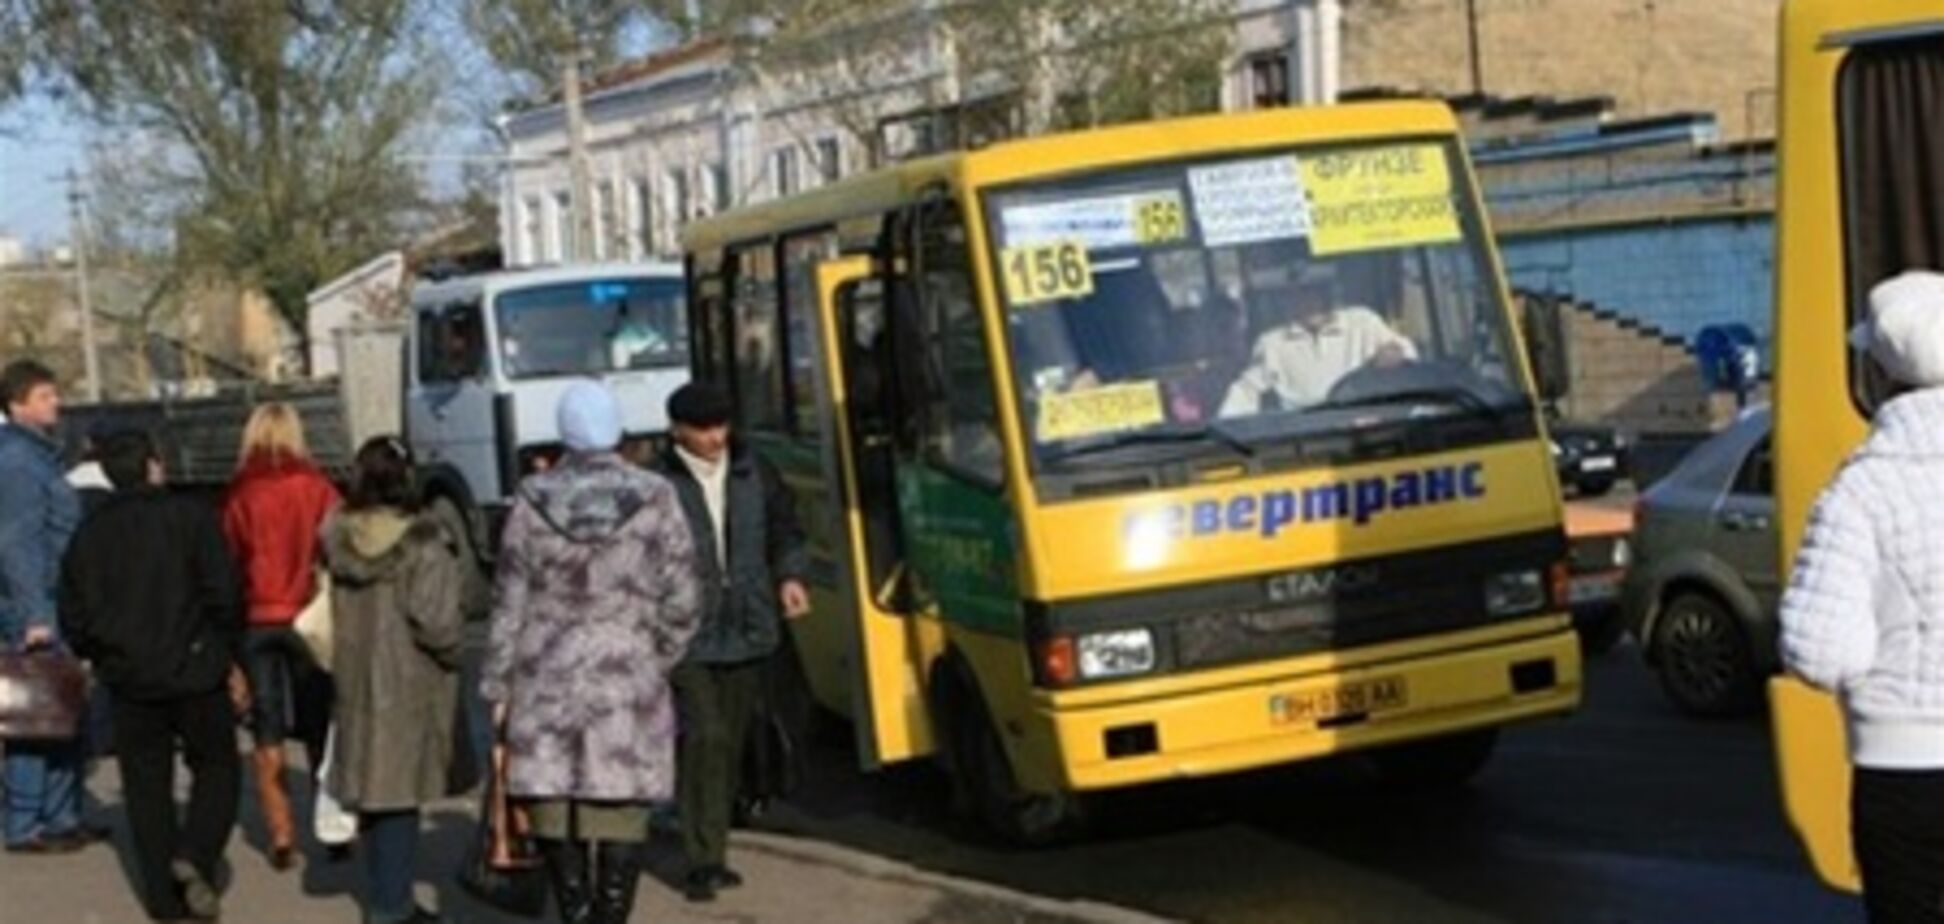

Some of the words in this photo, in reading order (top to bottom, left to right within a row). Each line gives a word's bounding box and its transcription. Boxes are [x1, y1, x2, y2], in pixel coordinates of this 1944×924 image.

[1313, 149, 1424, 179] ФРУНЗЕ
[1139, 201, 1178, 243] 156
[1010, 243, 1085, 297] 156
[1122, 460, 1487, 538] евертранс
